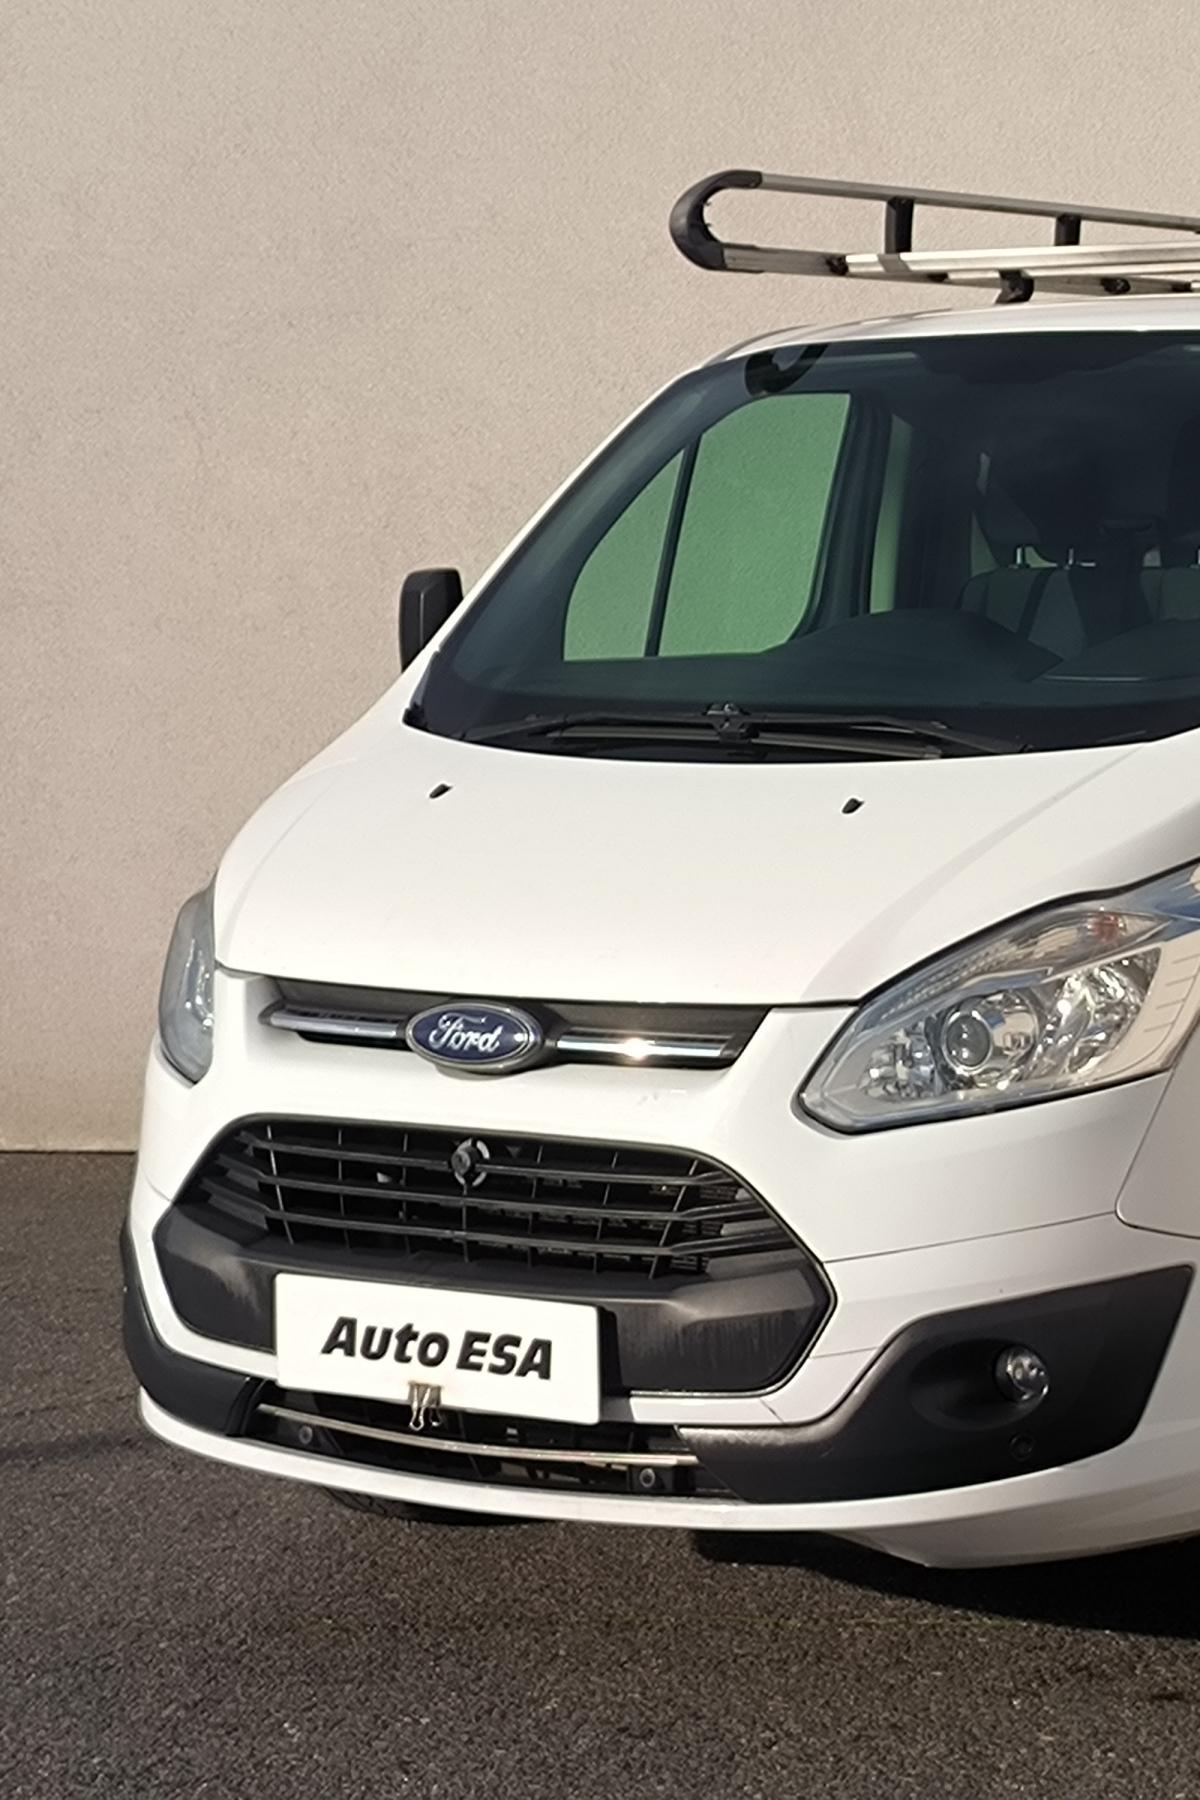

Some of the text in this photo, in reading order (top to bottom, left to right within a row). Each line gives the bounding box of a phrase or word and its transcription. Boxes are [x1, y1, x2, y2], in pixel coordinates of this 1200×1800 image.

[429, 1012, 504, 1053] Ford
[320, 1316, 553, 1381] Auto ESA
